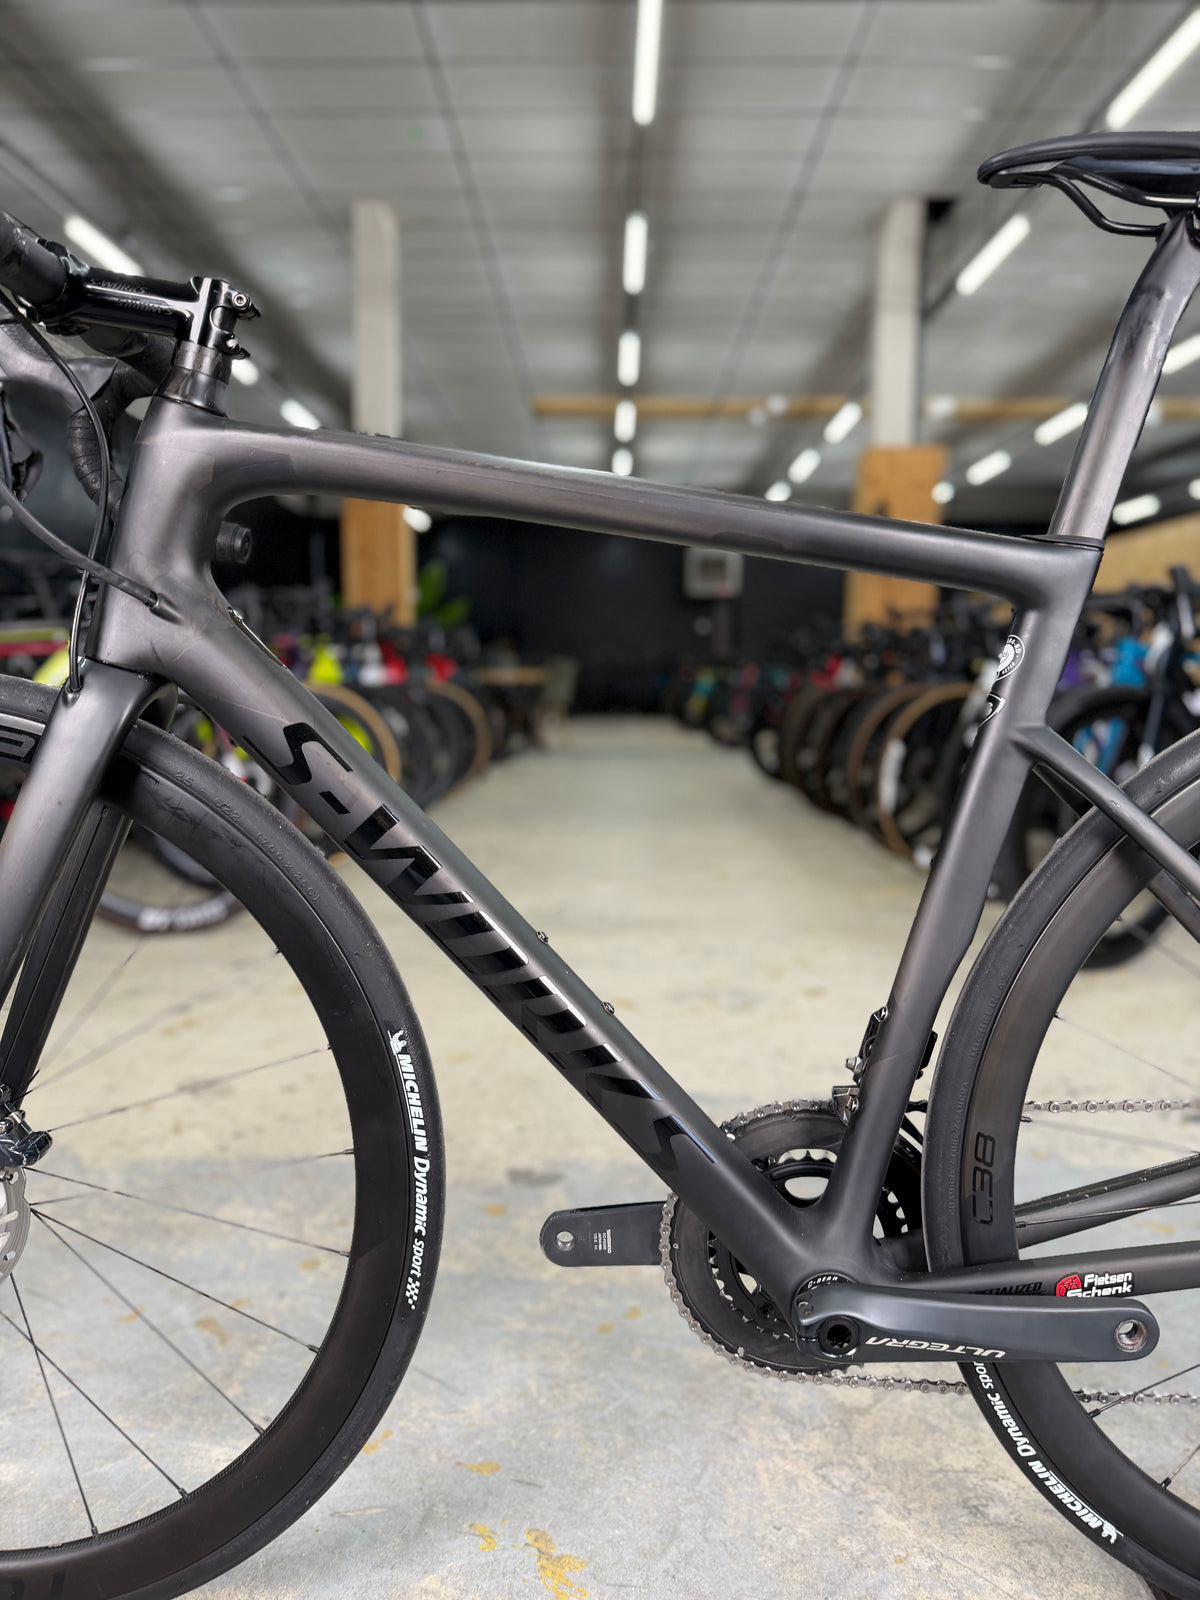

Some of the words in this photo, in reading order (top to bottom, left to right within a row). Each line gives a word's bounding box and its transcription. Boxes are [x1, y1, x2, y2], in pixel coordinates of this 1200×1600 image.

[398, 1053, 428, 1151] MICHELIN
[413, 1156, 430, 1236] Dynamic
[972, 1131, 996, 1226] C38
[410, 1238, 425, 1279] sport
[1084, 1272, 1132, 1288] Fietsen
[1066, 1281, 1132, 1298] Schenk
[865, 1336, 1006, 1359] ULTEGRA
[973, 1361, 994, 1390] spor
[987, 1392, 1036, 1457] Dynamic
[1028, 1460, 1103, 1529] MICHELIN
